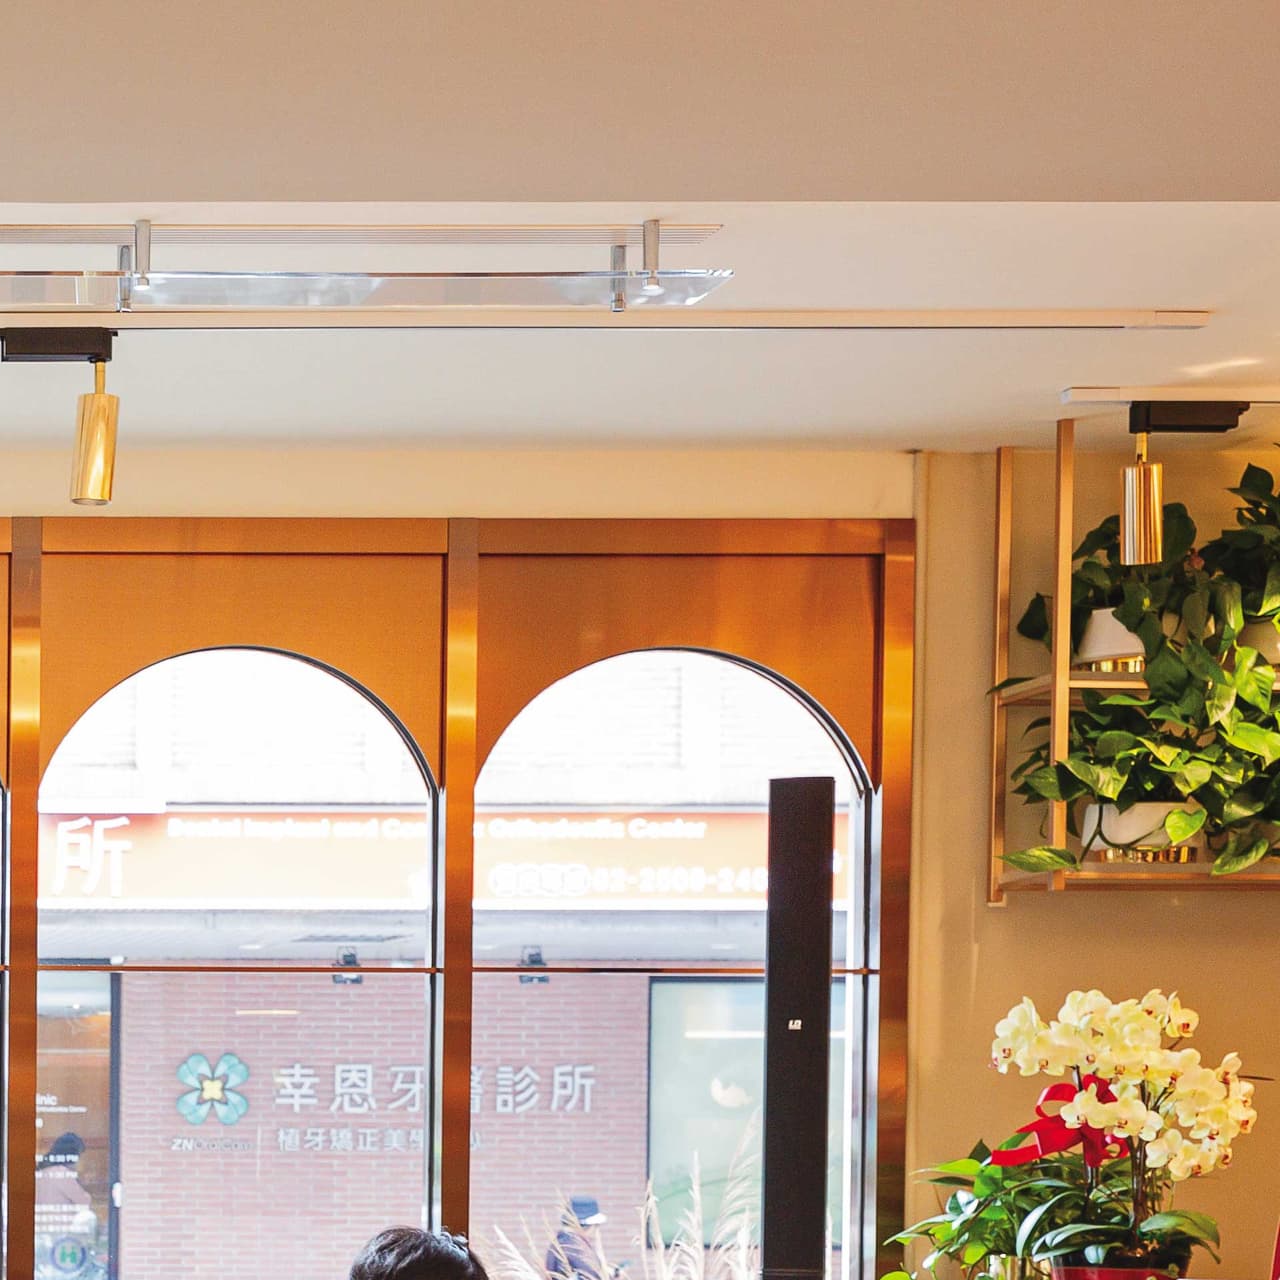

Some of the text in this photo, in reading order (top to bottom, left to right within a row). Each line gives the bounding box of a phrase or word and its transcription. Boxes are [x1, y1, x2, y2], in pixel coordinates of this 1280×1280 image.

[274, 1063, 597, 1114] 幸恩牙診所
